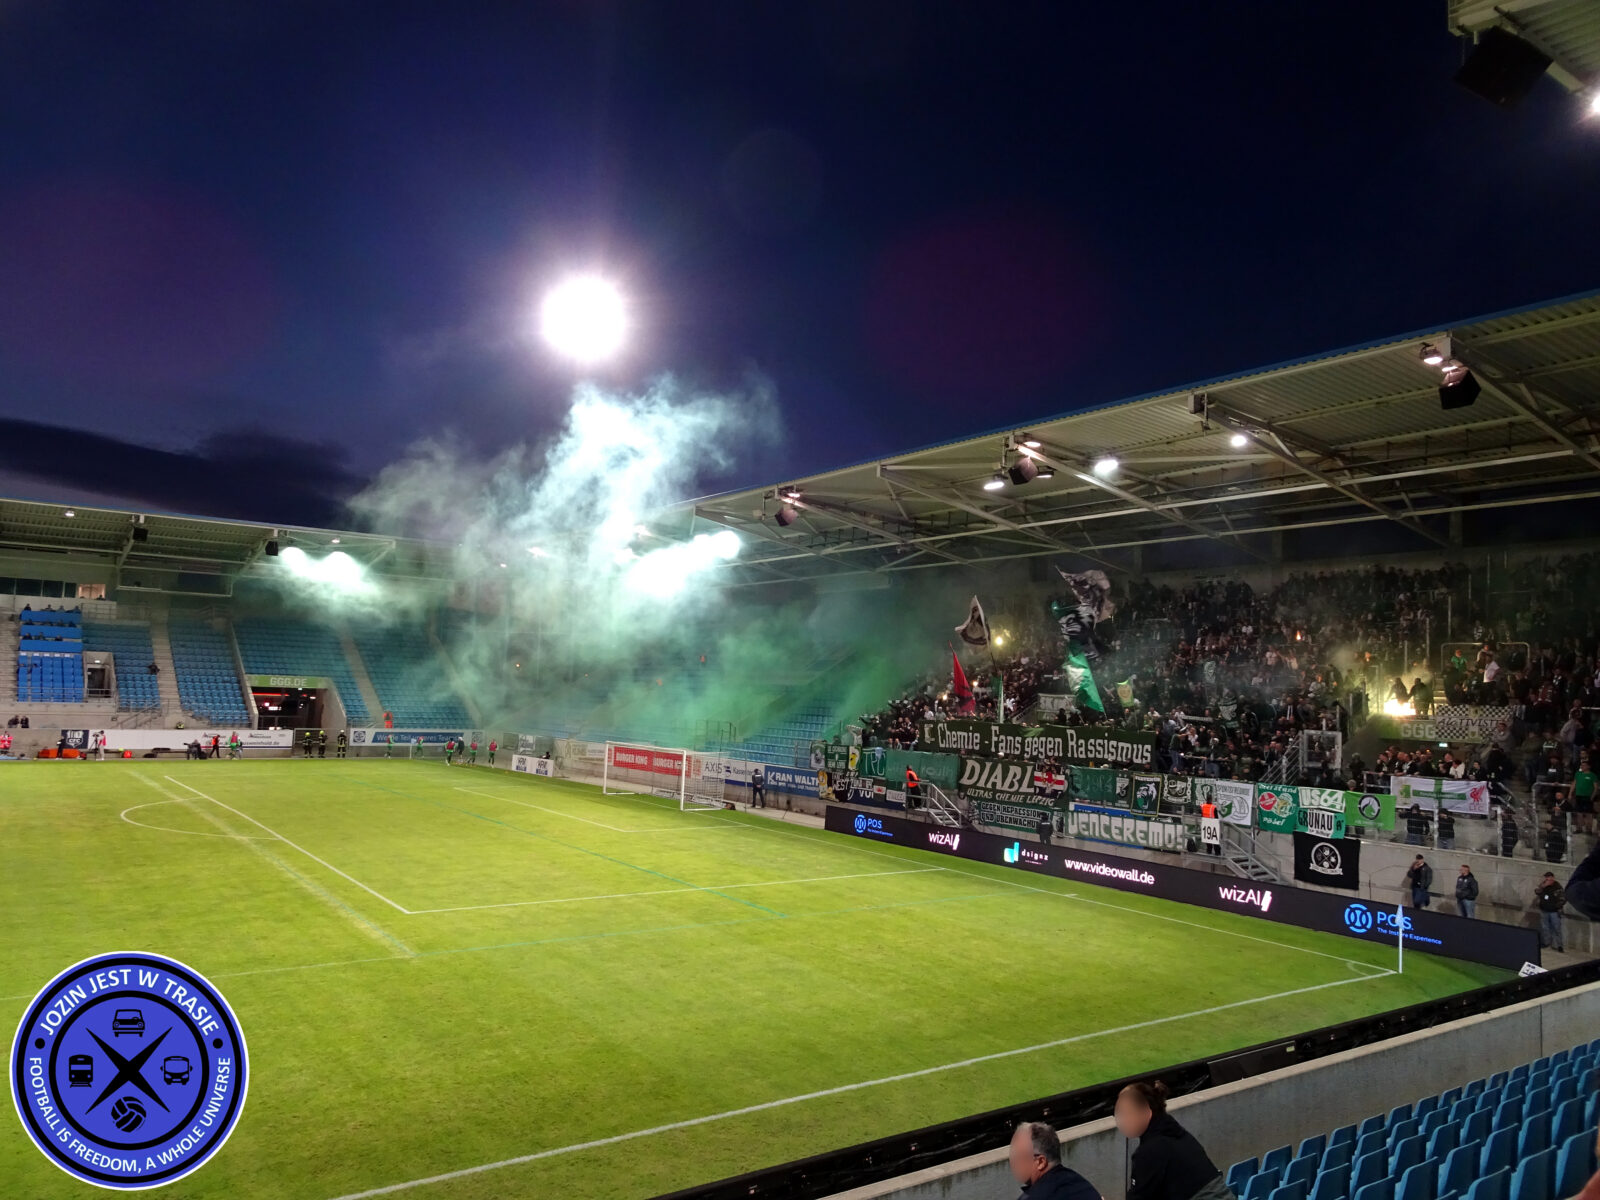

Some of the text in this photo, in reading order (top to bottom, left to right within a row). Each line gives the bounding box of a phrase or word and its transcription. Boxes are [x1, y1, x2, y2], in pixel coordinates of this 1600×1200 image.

[937, 723, 981, 750] Chemie
[1024, 736, 1063, 759] gegen
[1066, 729, 1152, 764] Rassismus
[616, 752, 648, 765] BURGER KING
[652, 757, 674, 768] BURGER
[767, 771, 793, 785] KRAN
[959, 759, 1037, 793] DIABL
[966, 788, 993, 799] ULTRAS
[995, 792, 1025, 803] CHEMIE
[981, 802, 1001, 813] GEGEN
[1297, 809, 1333, 831] GRÜNAU
[1202, 826, 1218, 841] 19A
[1064, 858, 1155, 885] www.videowall.de
[1388, 929, 1408, 938] Instre
[1409, 933, 1443, 945] Experience
